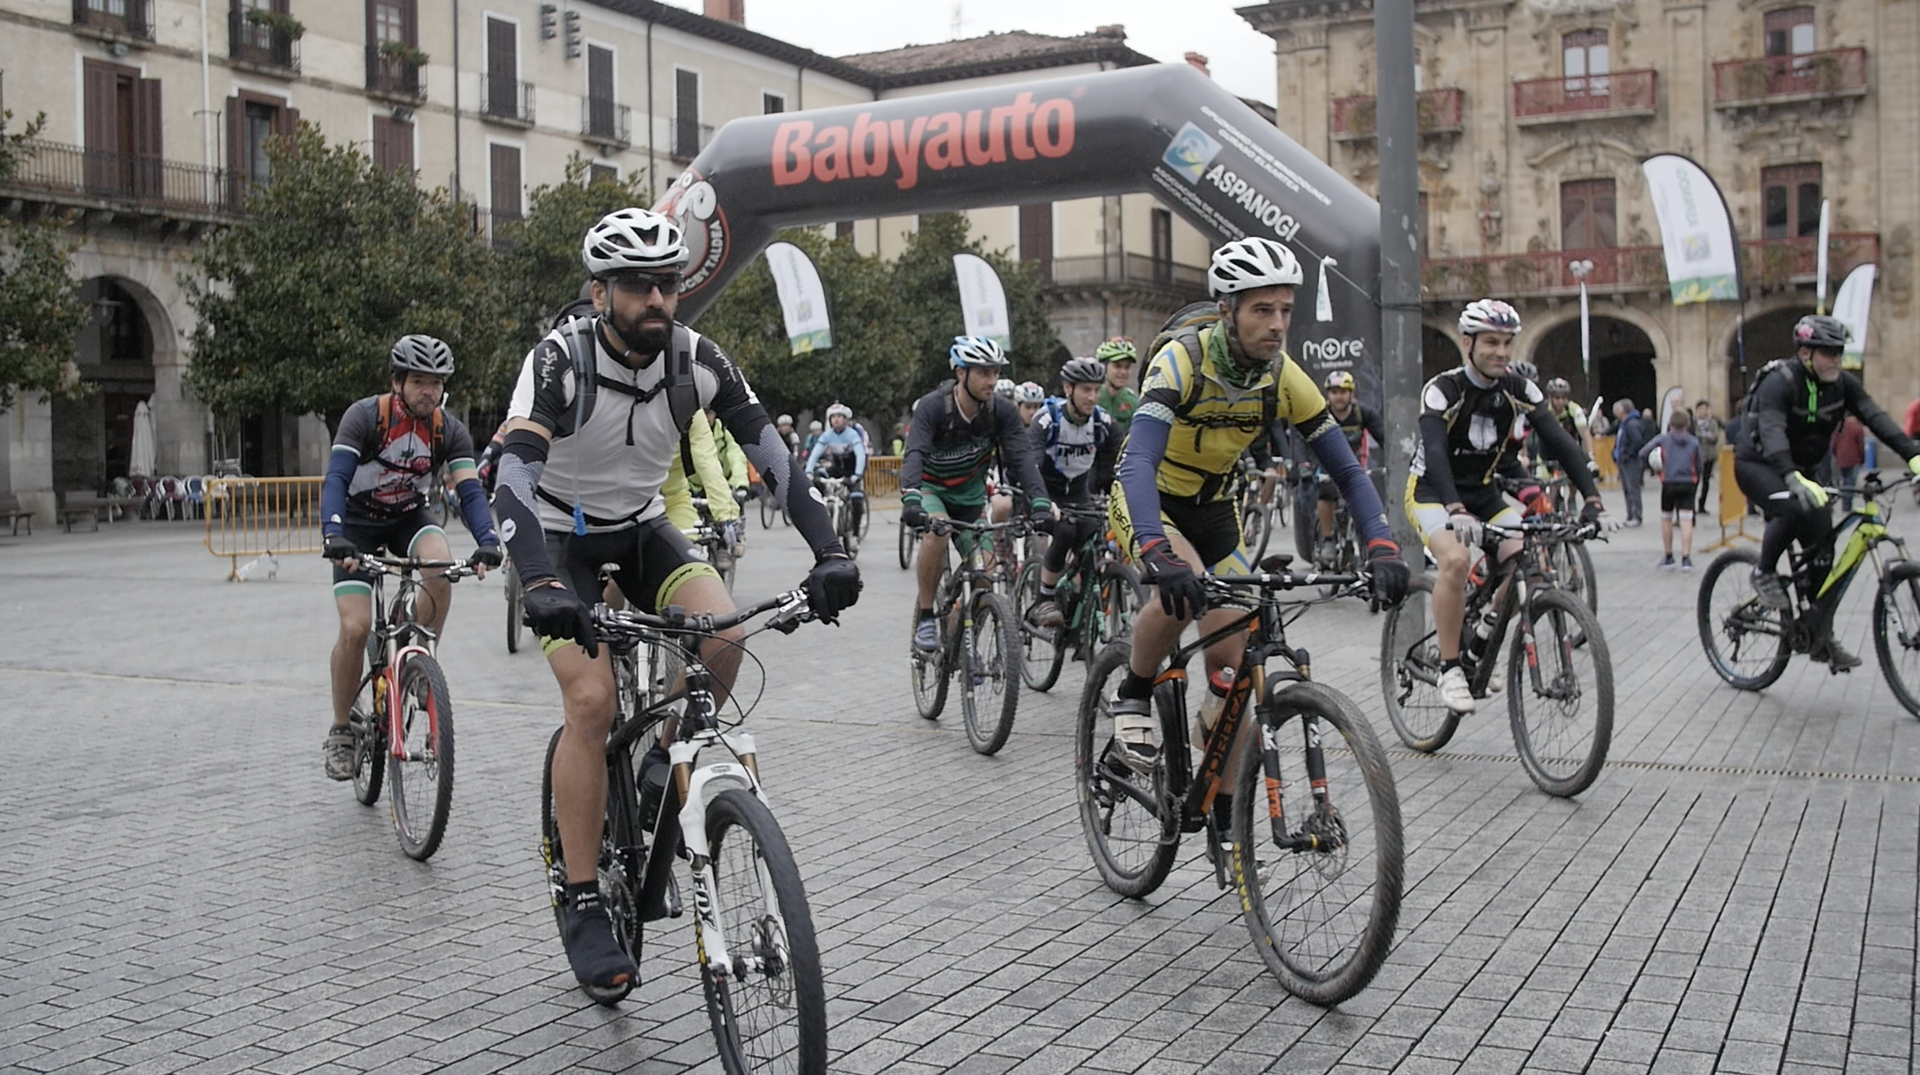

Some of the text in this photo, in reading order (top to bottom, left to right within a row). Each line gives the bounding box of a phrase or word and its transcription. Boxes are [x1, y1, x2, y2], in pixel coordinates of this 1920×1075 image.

[771, 91, 1076, 190] Babyauto
[1206, 164, 1300, 242] ASPANOGI
[679, 268, 710, 293] UGBY
[693, 873, 717, 930] FOX
